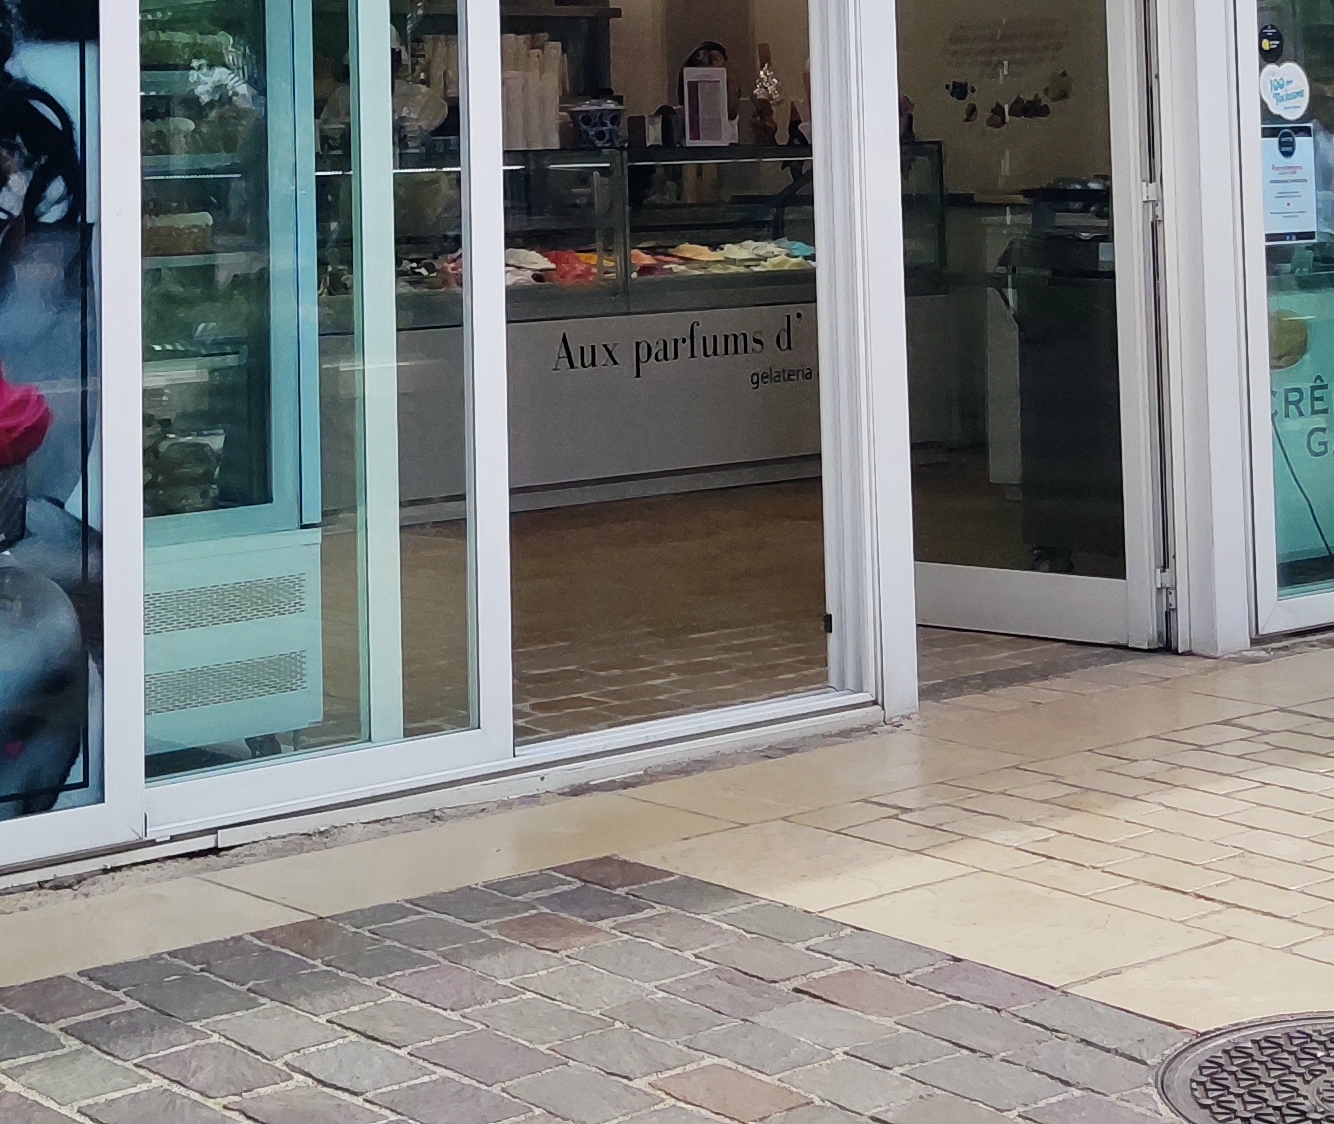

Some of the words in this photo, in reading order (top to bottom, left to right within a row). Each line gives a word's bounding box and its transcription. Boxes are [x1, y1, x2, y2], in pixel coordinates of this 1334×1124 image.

[552, 331, 620, 371] Aux
[633, 320, 765, 379] parfums
[775, 311, 803, 352] d'
[749, 367, 813, 390] gelateria
